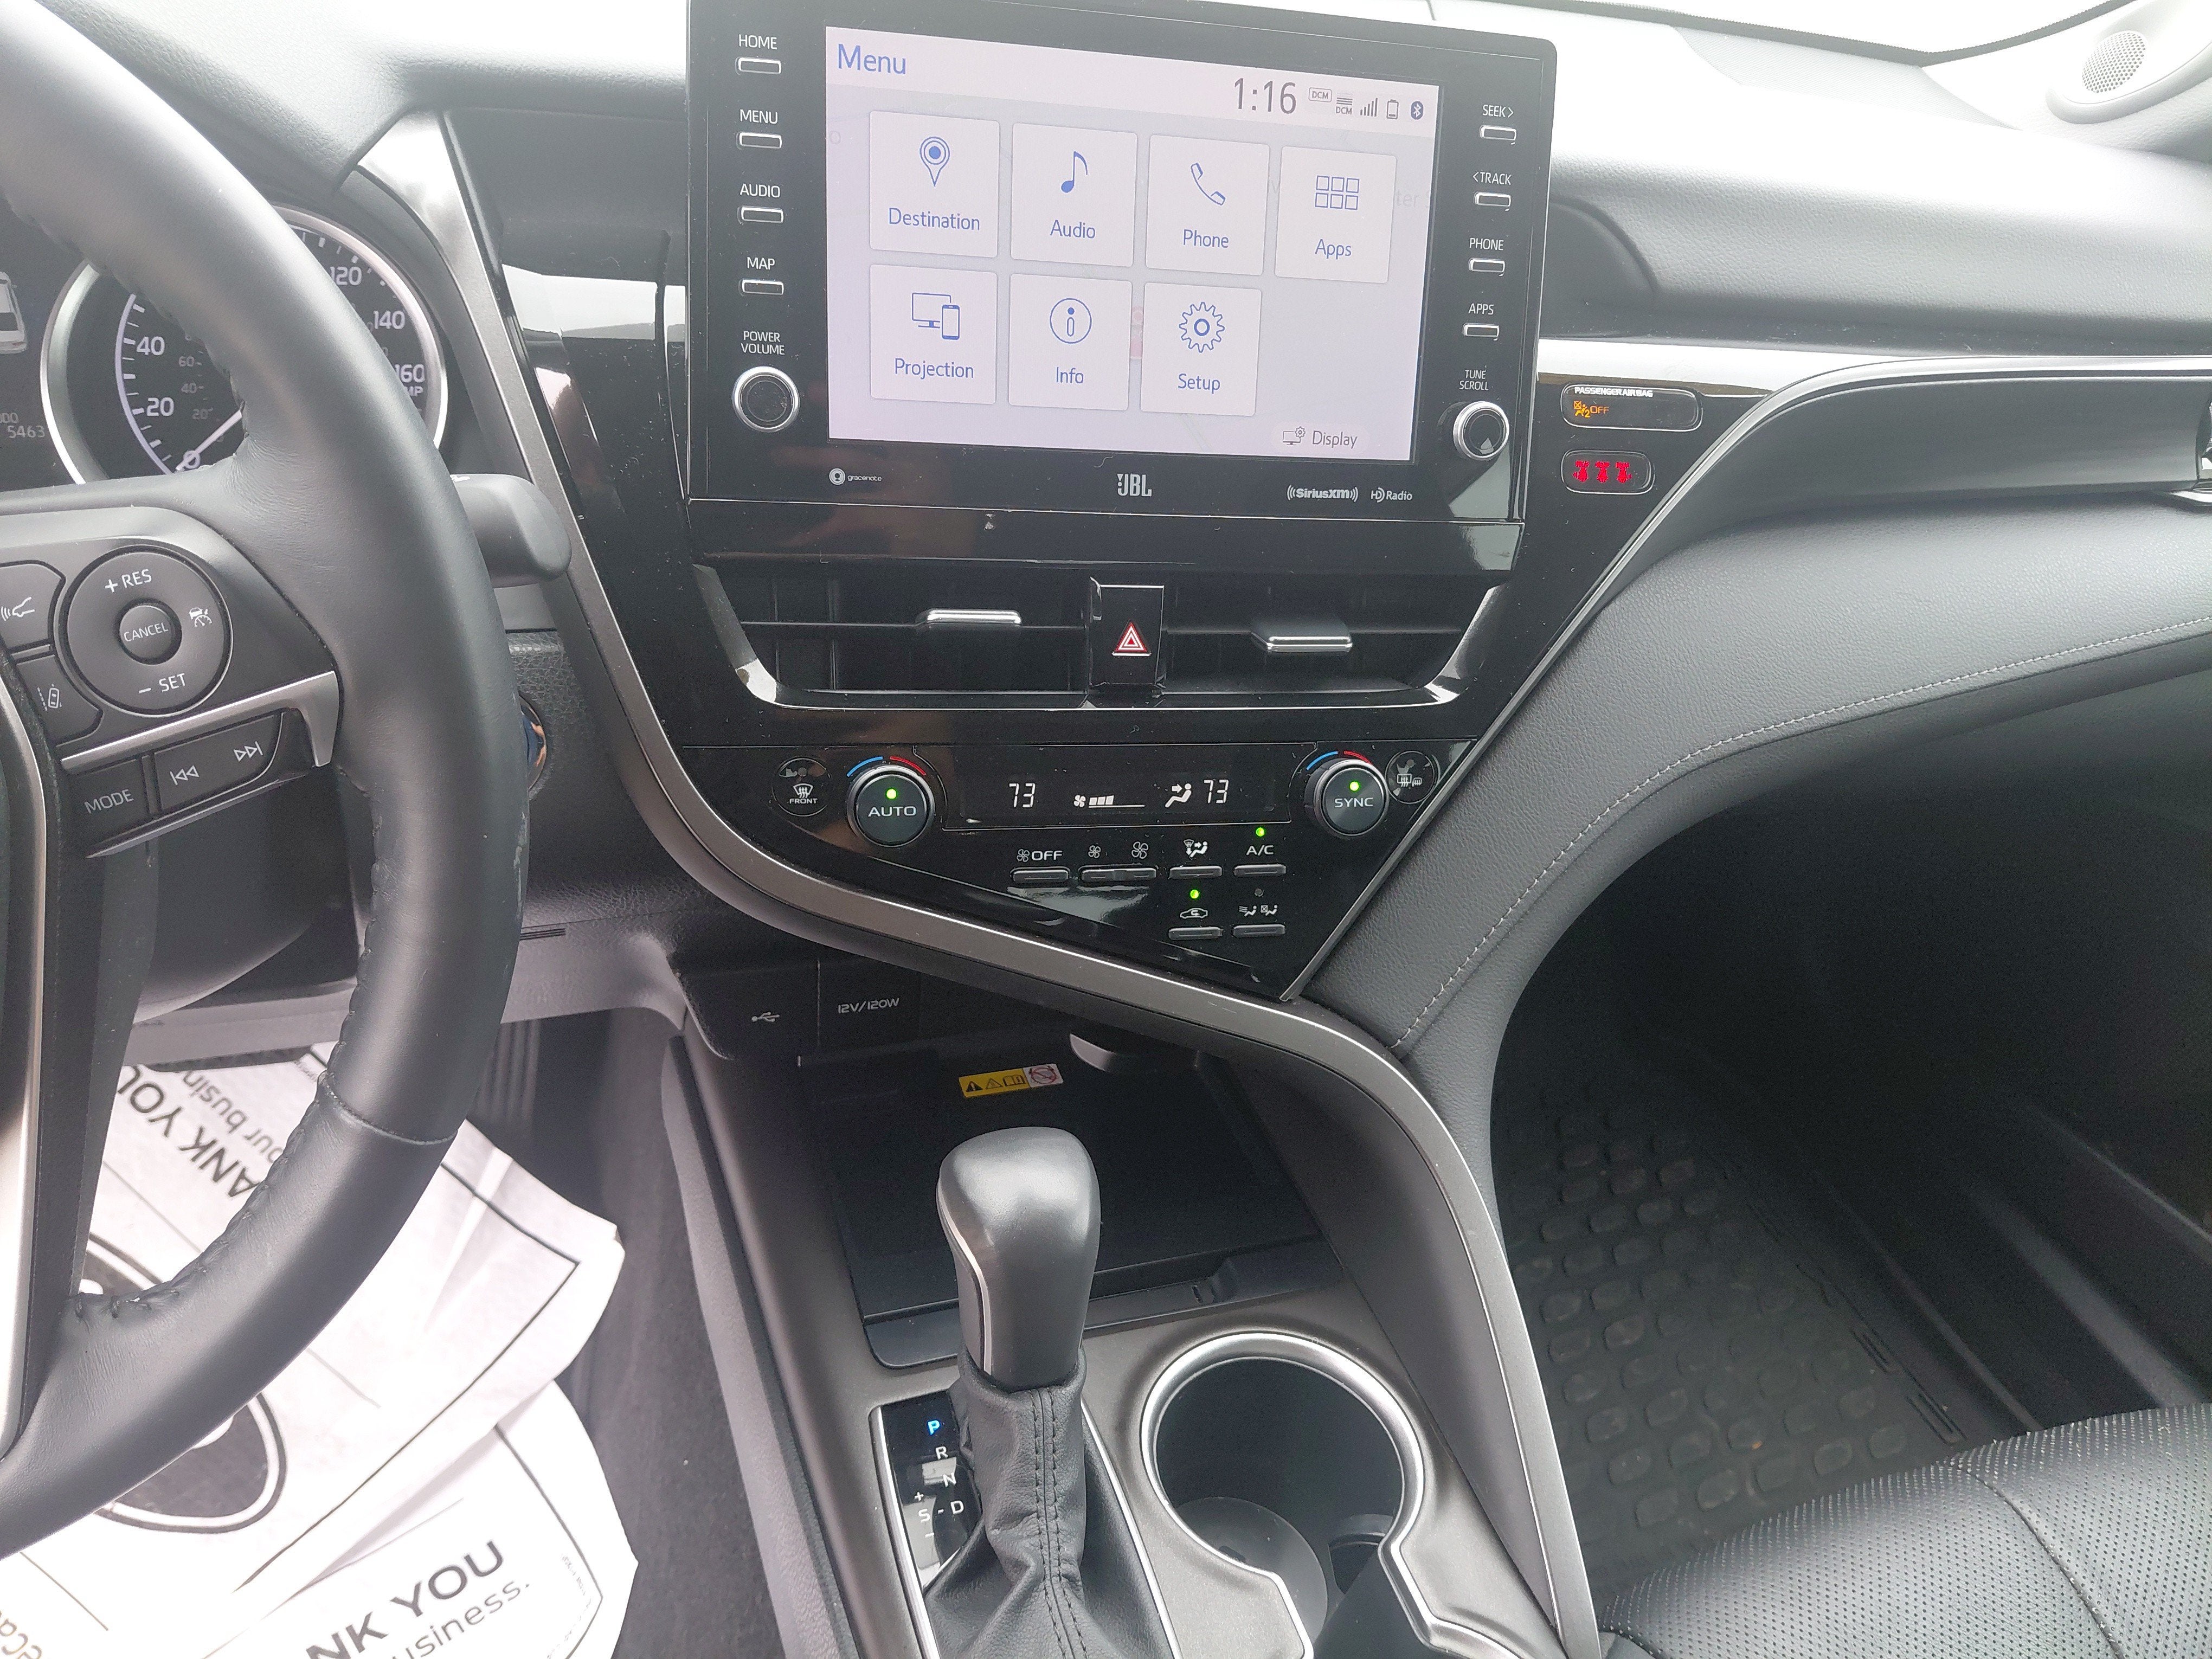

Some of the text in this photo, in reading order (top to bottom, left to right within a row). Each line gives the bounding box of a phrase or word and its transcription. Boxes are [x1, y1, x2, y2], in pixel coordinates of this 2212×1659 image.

[738, 34, 778, 50] HOME
[838, 44, 906, 75] Menu
[1233, 78, 1296, 114] 1:16
[1311, 91, 1329, 99] DCM
[740, 110, 778, 125] MENU
[1335, 106, 1352, 115] DCM
[740, 183, 781, 198] AUDIO
[889, 208, 980, 231] Destination
[1050, 220, 1096, 239] Audio
[1183, 229, 1229, 249] Phone
[1469, 237, 1504, 250] PHONE
[1315, 239, 1352, 260] Apps
[747, 257, 775, 270] MAP
[1468, 303, 1494, 315] APPS
[373, 310, 406, 330] 140
[743, 331, 781, 343] POWER
[137, 336, 165, 356] 40
[741, 343, 785, 355] VOLUME
[178, 356, 195, 367] 60
[894, 358, 974, 380] Projection
[1056, 367, 1084, 385] Info
[1464, 369, 1487, 380] TUNE
[181, 383, 197, 394] 40
[1177, 373, 1221, 394] Setup
[1459, 380, 1489, 391] SCROLL
[1574, 387, 1622, 396] PASSENGER
[1636, 389, 1653, 397] BAG
[146, 397, 175, 416] 20
[1590, 406, 1610, 414] OFF
[7, 425, 45, 439] 5463
[1311, 429, 1358, 449] Display
[1117, 473, 1152, 497] JBL
[1386, 490, 1412, 500] Radio
[122, 568, 152, 590] RES
[124, 621, 169, 642] CANCEL
[159, 672, 186, 693] SET
[1009, 782, 1036, 808] 73
[1203, 779, 1229, 804] 73
[84, 788, 134, 814] MODE
[1334, 797, 1374, 808] SYNC
[868, 806, 916, 817] AUTO
[1031, 850, 1063, 861] OFF
[1246, 844, 1274, 856] A/C
[838, 998, 899, 1014] 12V/120W
[927, 1419, 940, 1435] P
[935, 1446, 949, 1459] R
[943, 1473, 957, 1487] N
[950, 1500, 964, 1515] D
[389, 1540, 504, 1617] YOU
